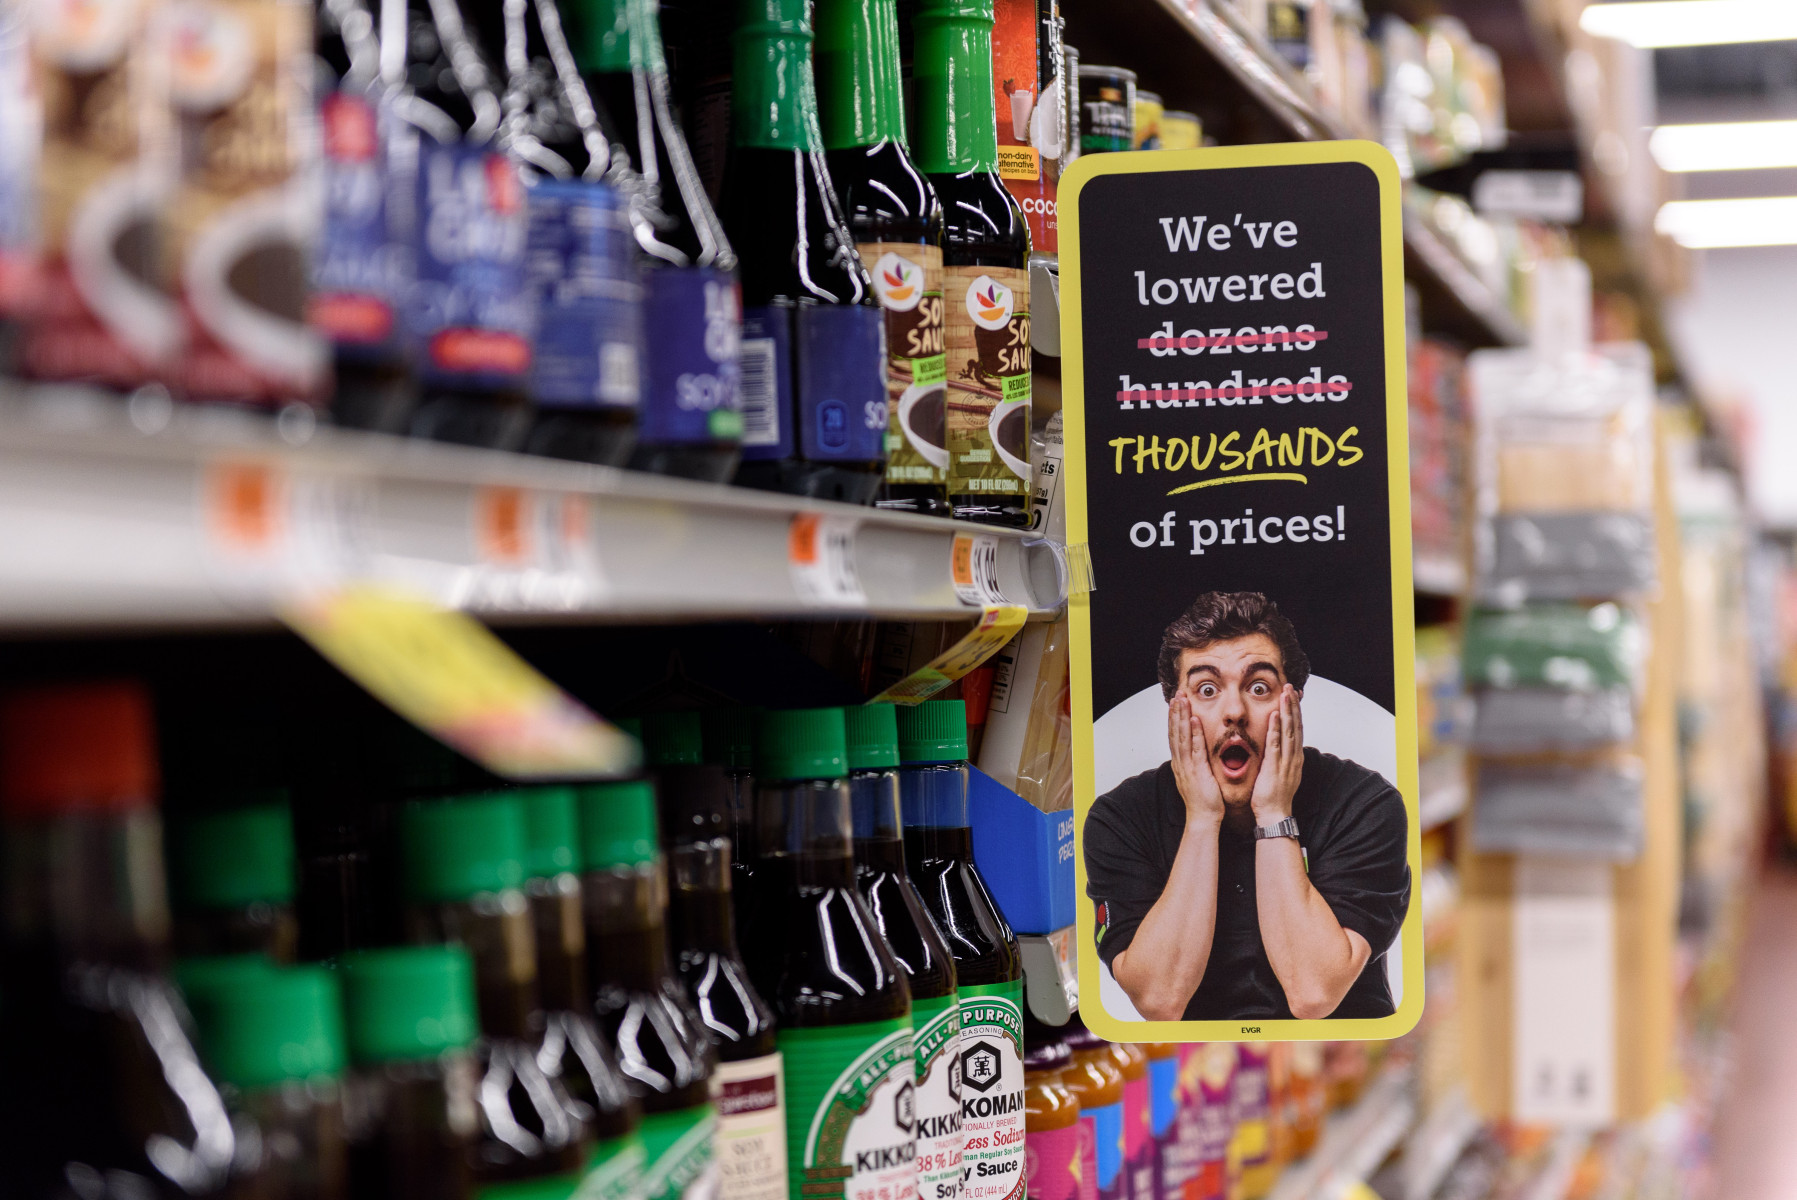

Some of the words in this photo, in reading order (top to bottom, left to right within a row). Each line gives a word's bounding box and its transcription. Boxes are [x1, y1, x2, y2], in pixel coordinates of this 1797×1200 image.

[998, 152, 1032, 161] non-dairy
[1159, 213, 1298, 253] We've
[1134, 262, 1326, 306] lowered
[1148, 322, 1317, 357] dozens
[1119, 367, 1349, 410] hundreds
[1108, 426, 1364, 474] THOUSANDS
[968, 479, 980, 491] NET
[1129, 510, 1176, 548] of
[1190, 505, 1346, 556] prices!
[960, 1028, 1003, 1037] EASONING
[1241, 1026, 1261, 1034] EVGR
[979, 1149, 1003, 1160] Regular
[977, 1160, 1018, 1177] Sauce
[965, 1188, 973, 1199] FL
[975, 1186, 984, 1198] OZ
